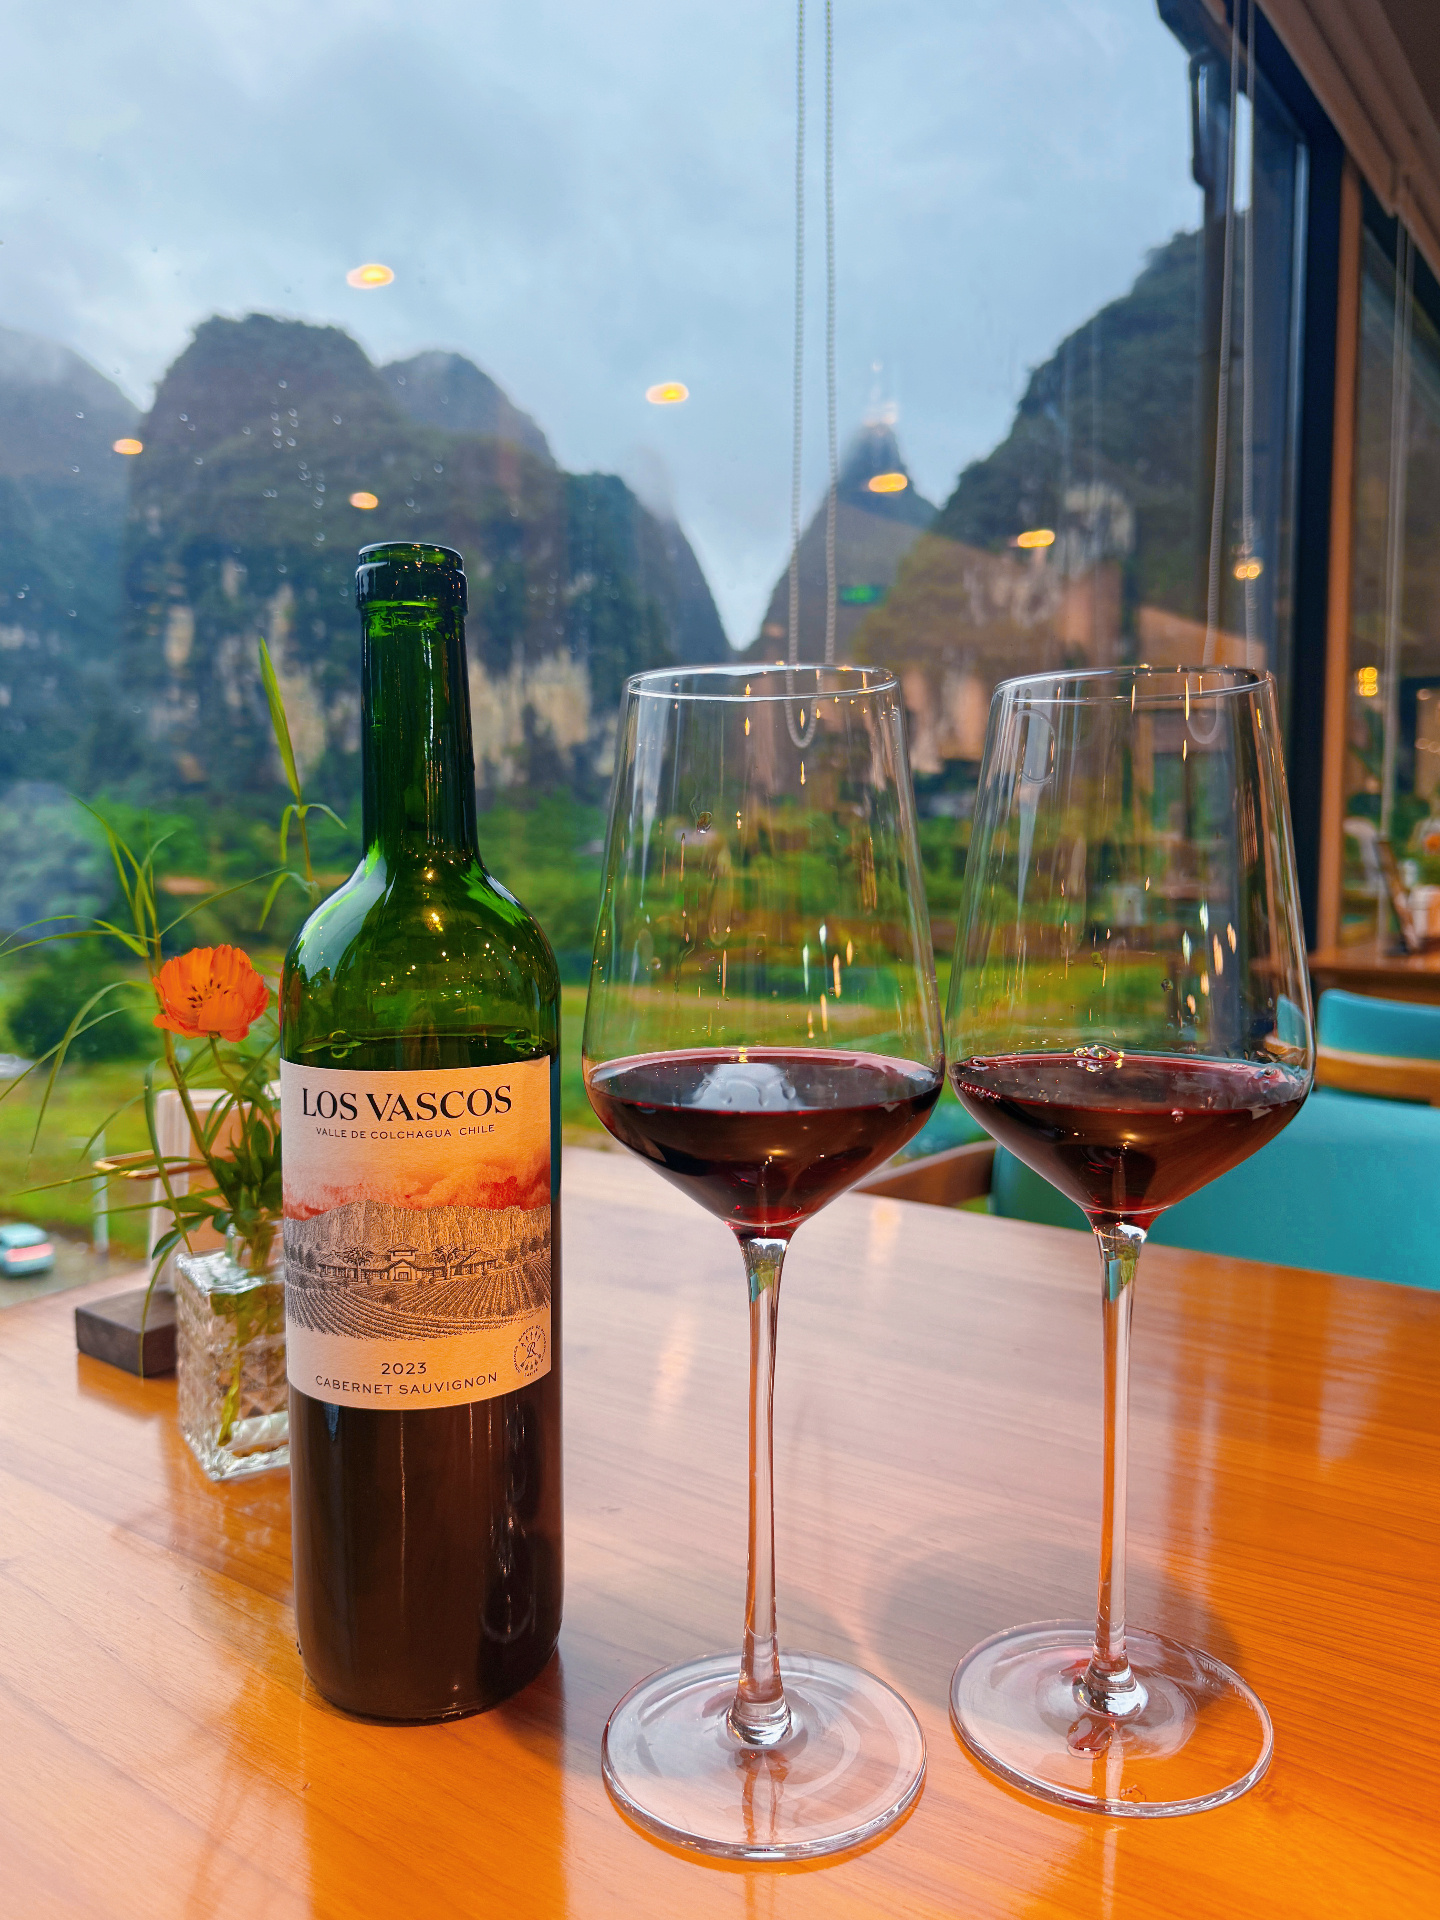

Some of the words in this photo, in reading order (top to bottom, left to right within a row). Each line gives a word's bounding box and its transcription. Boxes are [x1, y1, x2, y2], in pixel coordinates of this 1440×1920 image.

[302, 1087, 358, 1121] LOS
[366, 1085, 512, 1121] VASCOS
[315, 1126, 347, 1138] VALLE
[351, 1130, 367, 1139] DE
[370, 1128, 452, 1139] COLCHAGUA
[459, 1124, 495, 1136] CHILE
[381, 1362, 427, 1375] 2023
[315, 1375, 393, 1395] CABERNET
[399, 1372, 497, 1395] SAUVIGNON
